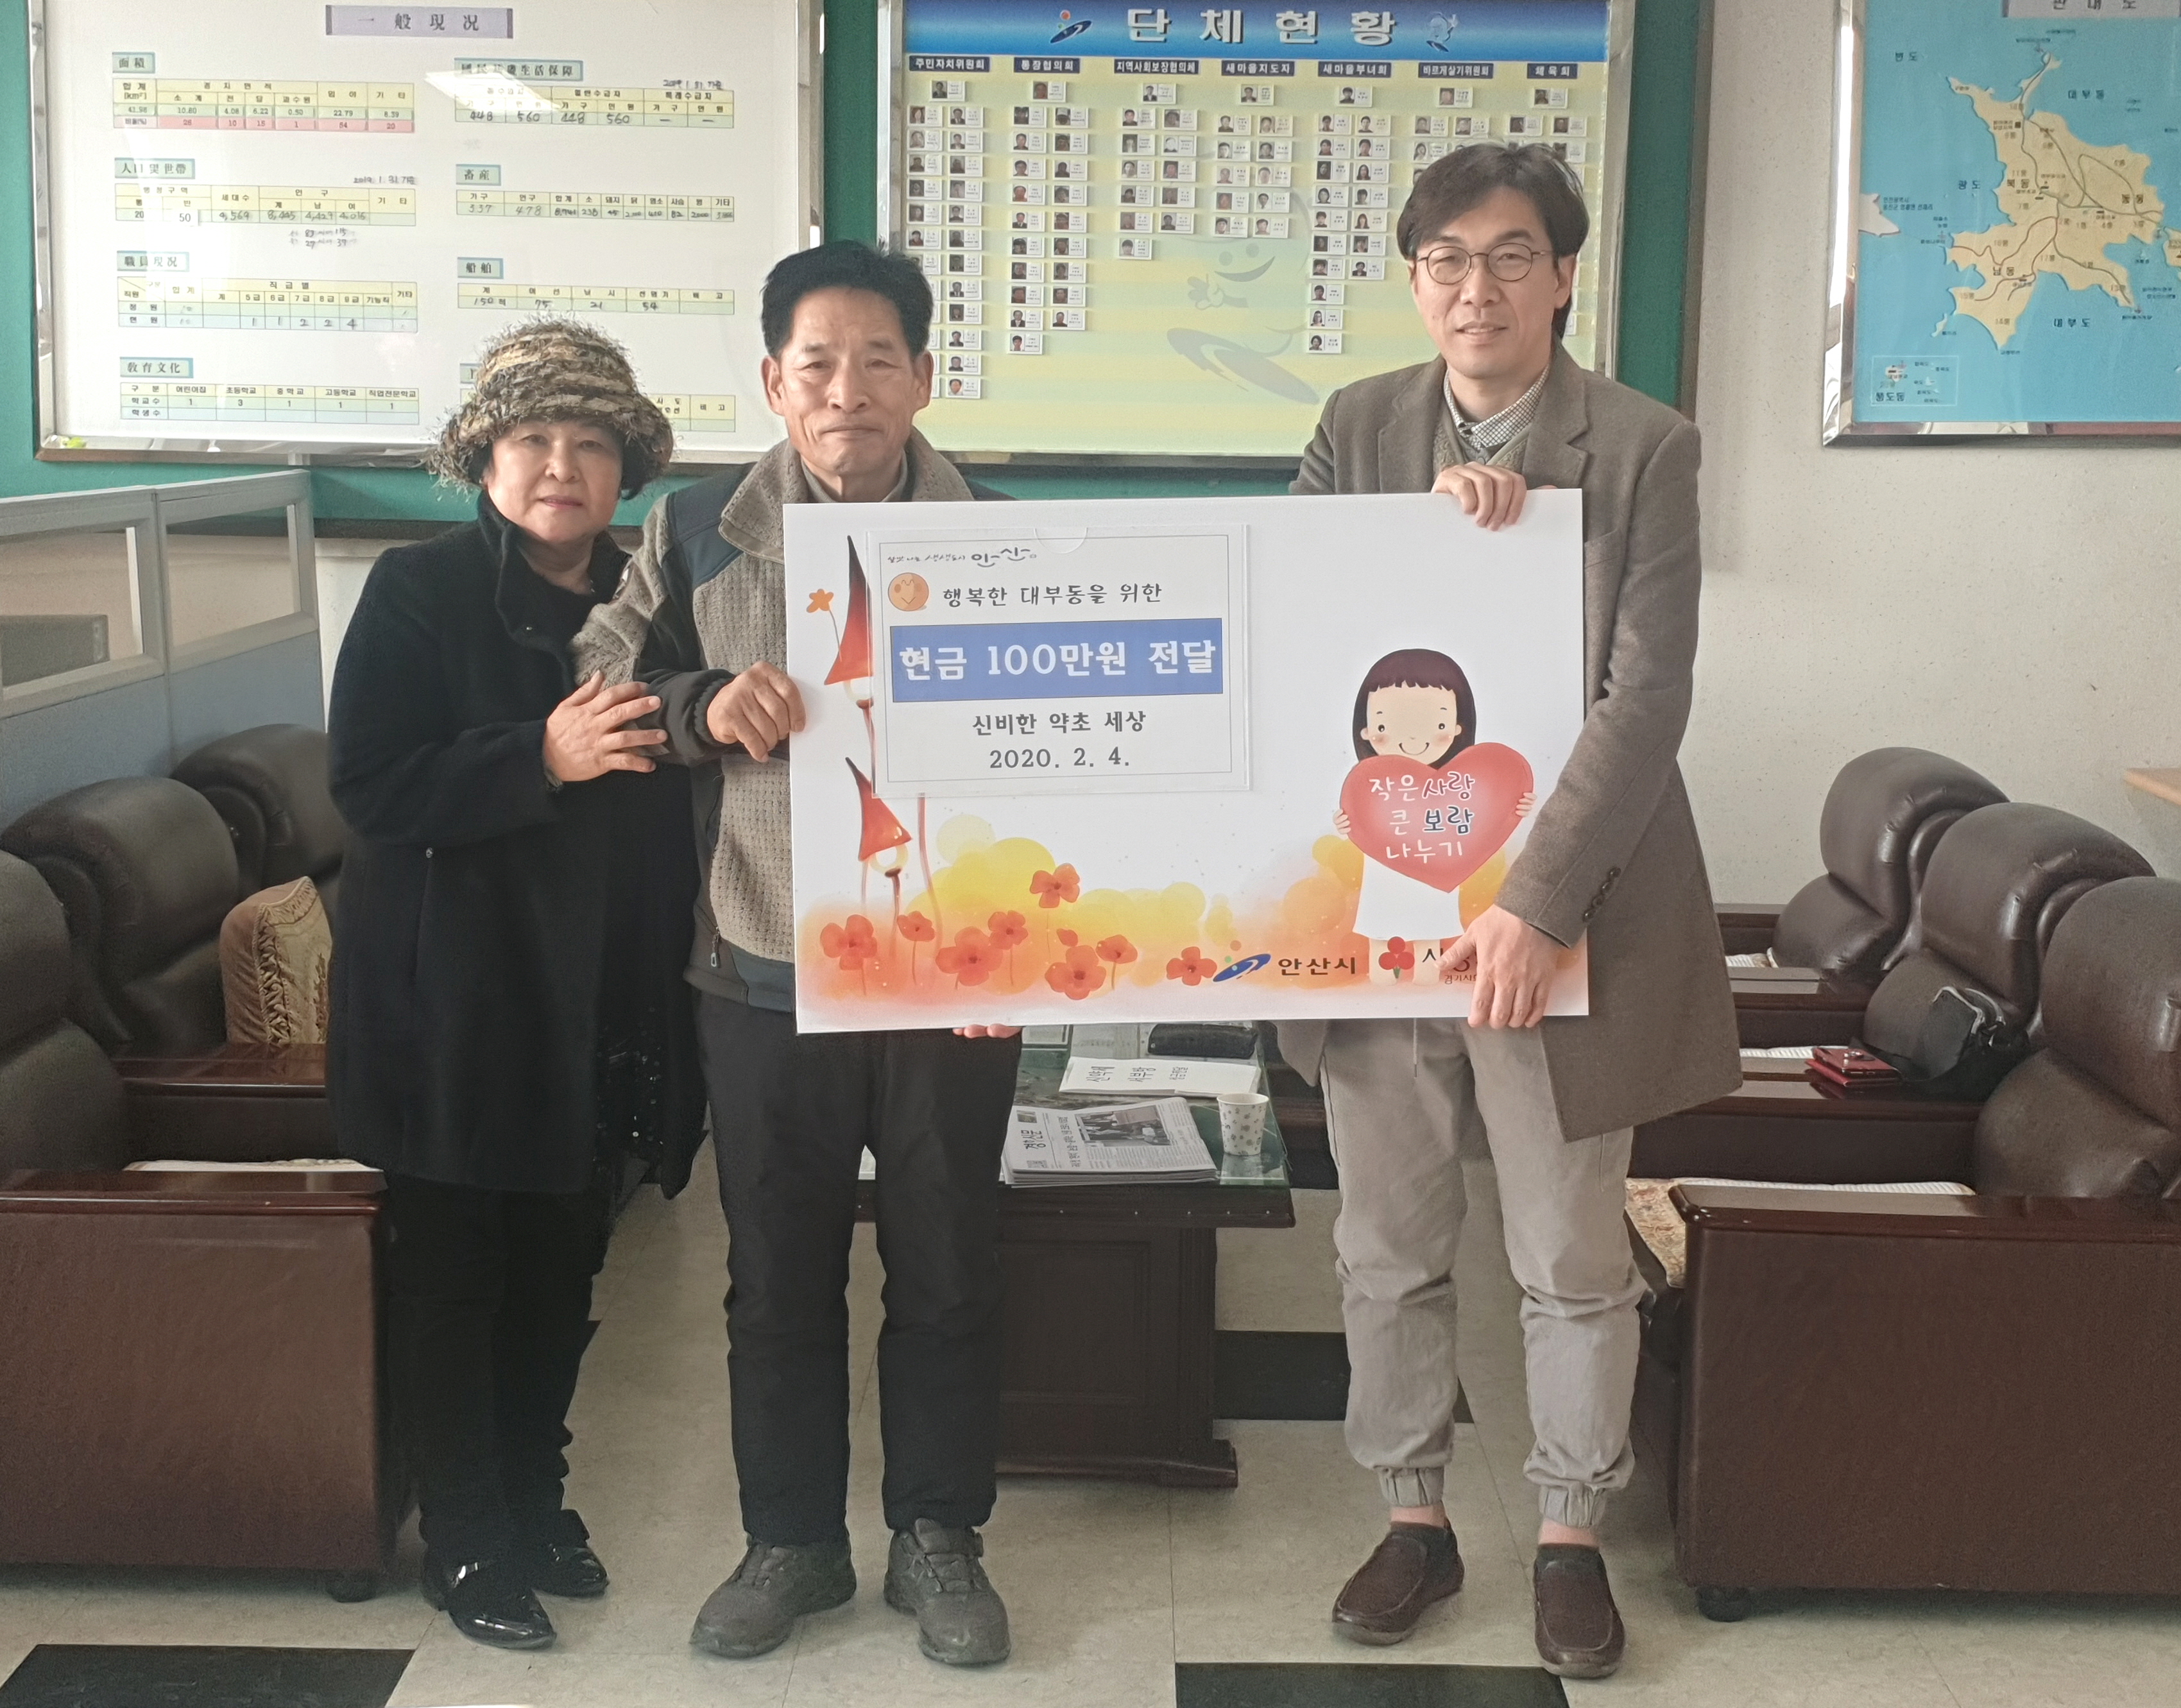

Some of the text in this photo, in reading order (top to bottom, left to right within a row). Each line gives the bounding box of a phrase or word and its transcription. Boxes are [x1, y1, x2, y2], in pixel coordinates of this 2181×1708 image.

[1127, 8, 1396, 46] 단체현황
[915, 58, 985, 70] 주민자치위원회
[1021, 59, 1074, 71] 통장협의회
[1116, 60, 1196, 73] 지역사회보장협의체
[1226, 64, 1290, 74] 새마을지도자
[1322, 64, 1387, 75] 새마을부녀회
[1423, 65, 1489, 76] 바르게살기위원회
[517, 110, 540, 121] 560
[606, 113, 630, 124] 560
[378, 196, 407, 205] 기타
[135, 210, 144, 219] 20
[516, 205, 542, 216] 478
[179, 213, 191, 222] 50
[269, 281, 309, 289] 직급별
[300, 318, 309, 327] 2
[323, 319, 332, 327] 2
[346, 318, 356, 330] 4
[369, 389, 416, 398] 직업전문학교
[971, 547, 1031, 568] 안산
[943, 583, 1163, 608] 행복한 대부동을 위한
[899, 639, 1216, 681] 현금 100만원 전달
[972, 710, 1147, 736] 신비한 약초 세상
[989, 746, 1130, 769] 2020. 2. 4.
[1369, 771, 1476, 802] 작은 사랑
[1389, 805, 1475, 835] 큰 보람
[1386, 839, 1463, 864] 나누기
[1278, 956, 1356, 977] 안산시
